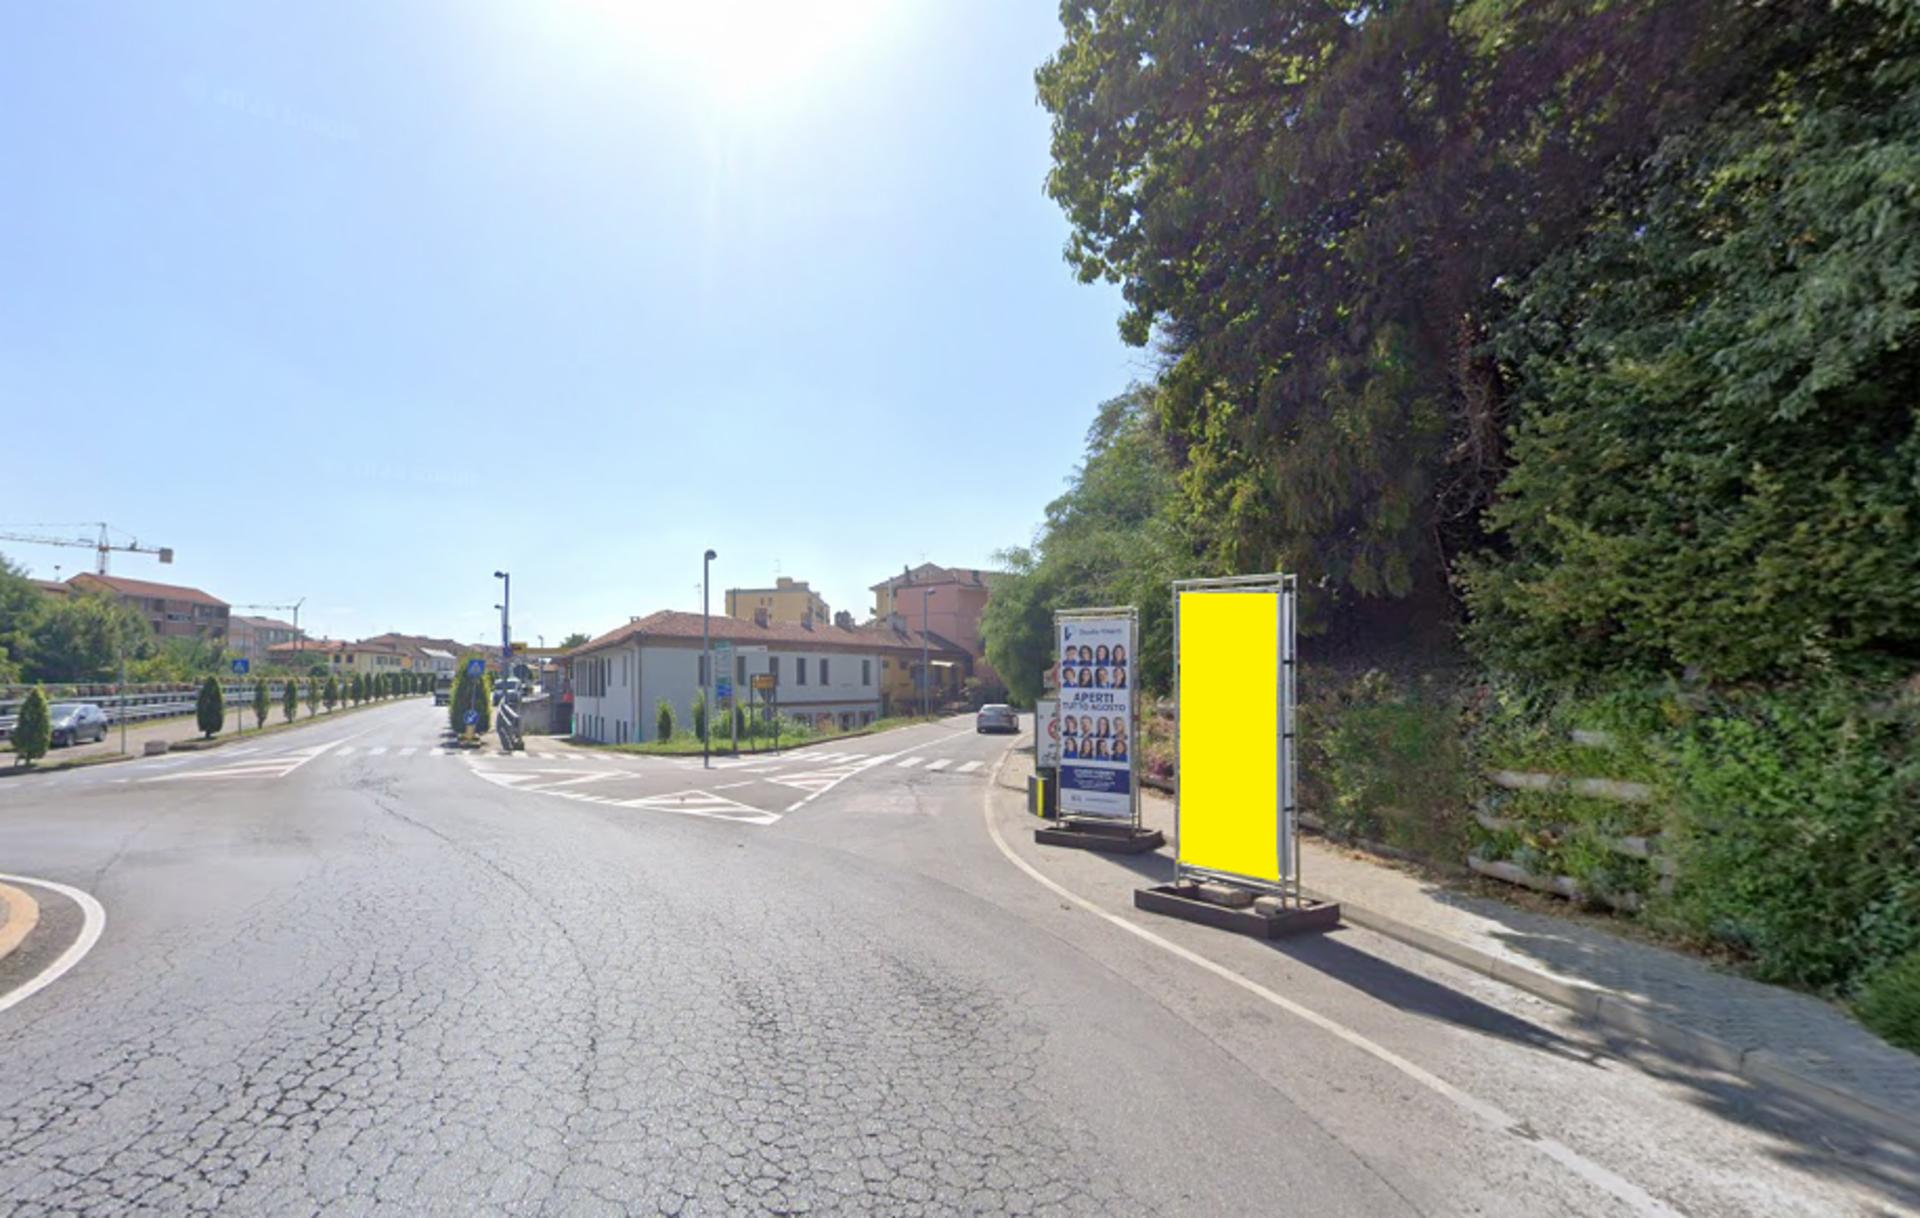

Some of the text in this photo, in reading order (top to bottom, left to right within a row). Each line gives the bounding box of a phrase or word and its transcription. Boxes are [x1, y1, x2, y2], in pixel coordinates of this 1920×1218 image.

[1073, 692, 1114, 703] APERTI
[1062, 702, 1126, 711] TUTTO AGOSTO
